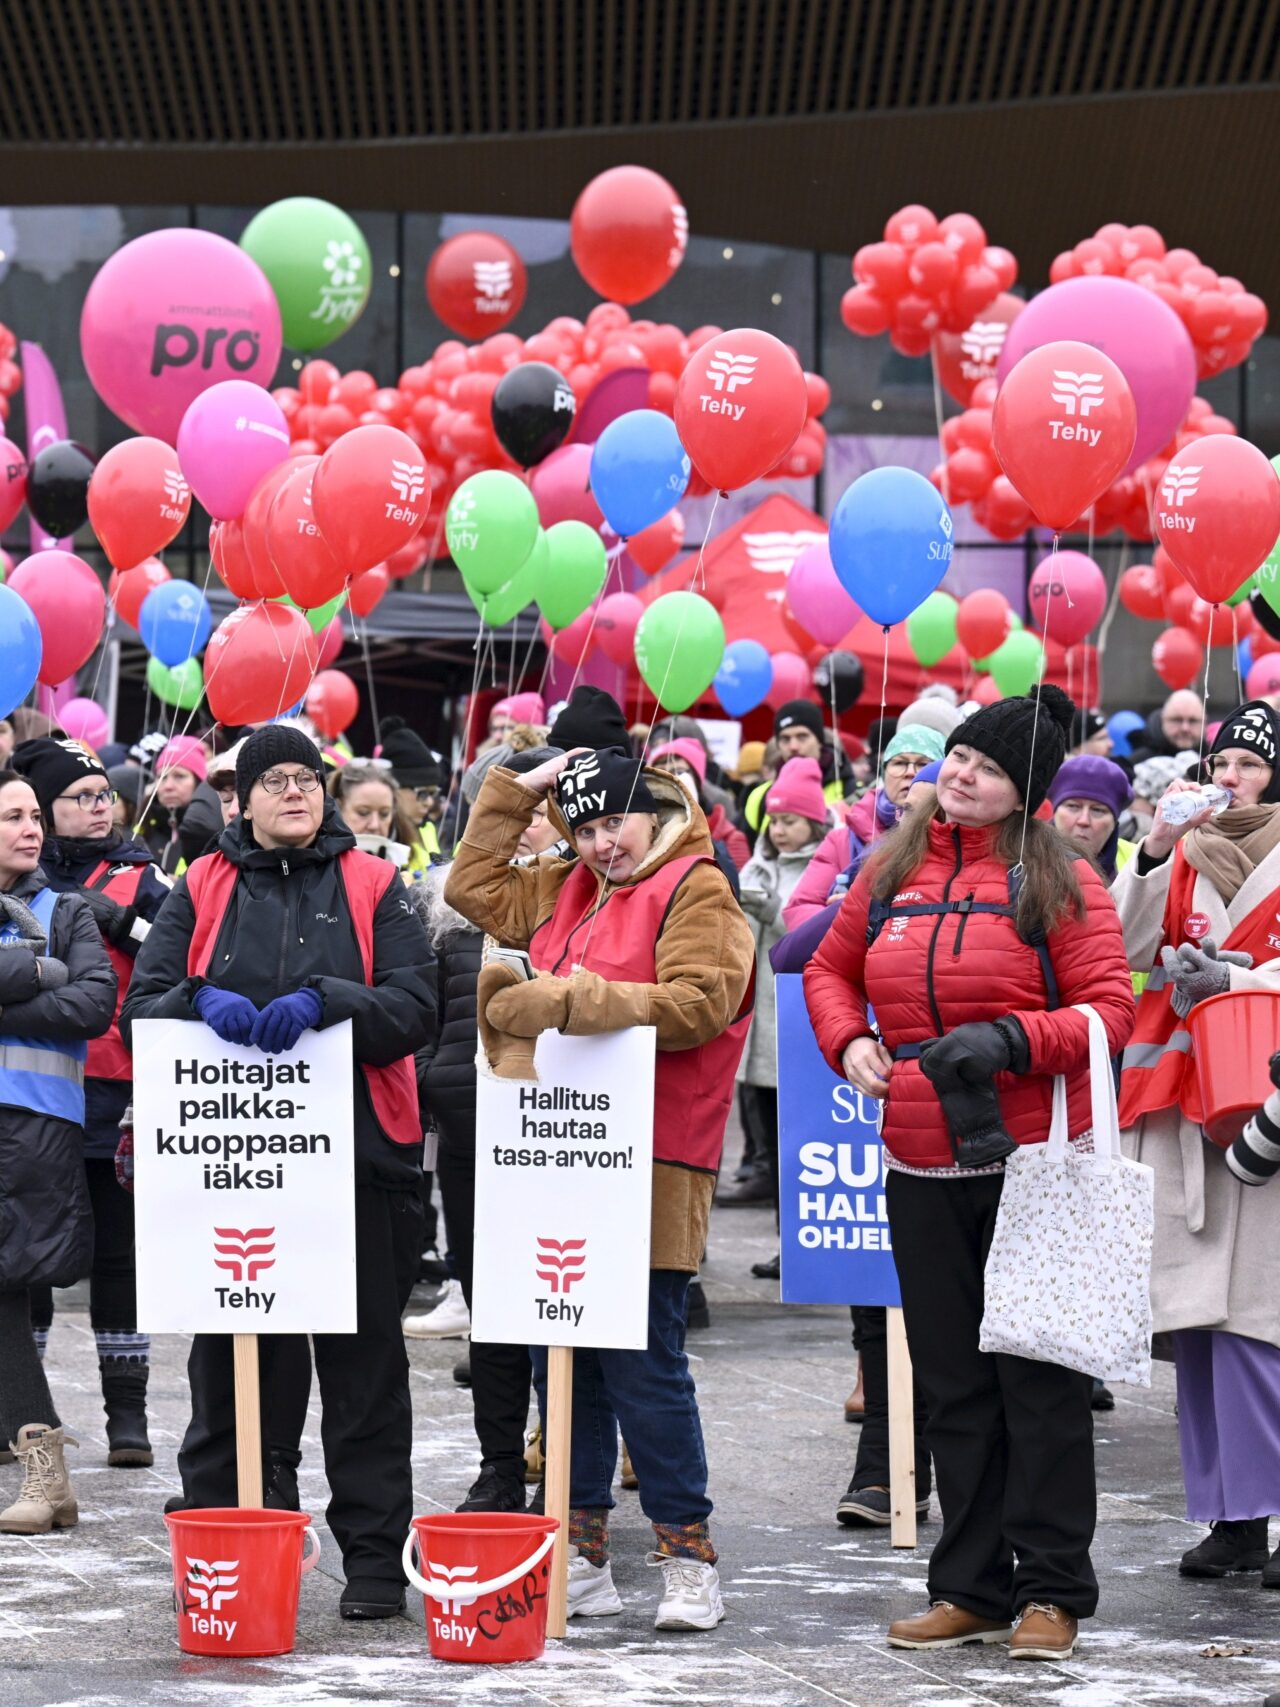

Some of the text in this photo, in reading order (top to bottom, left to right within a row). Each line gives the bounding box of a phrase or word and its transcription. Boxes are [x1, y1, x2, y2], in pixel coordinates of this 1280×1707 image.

[151, 323, 259, 377] pro
[700, 395, 746, 421] Tehy
[1048, 420, 1102, 447] Tehy
[160, 503, 186, 522] Tehy
[385, 503, 419, 526] Tehy
[1159, 512, 1196, 533] Tehy
[297, 519, 321, 537] Te
[1032, 582, 1064, 598] pro
[1233, 725, 1276, 759] Tehy
[77, 757, 104, 771] Te
[175, 1058, 311, 1092] Hoitajat
[179, 1093, 306, 1127] palkka-
[520, 1086, 610, 1111] Hallitus
[521, 1115, 607, 1139] hautaa
[156, 1128, 331, 1162] kuoppaan
[493, 1144, 633, 1169] tasa-arvon!
[203, 1163, 283, 1190] iäksi
[214, 1287, 276, 1314] Tehy
[535, 1298, 584, 1327] Tehy
[188, 1612, 237, 1642] Tehy
[432, 1617, 477, 1648] Tehy
